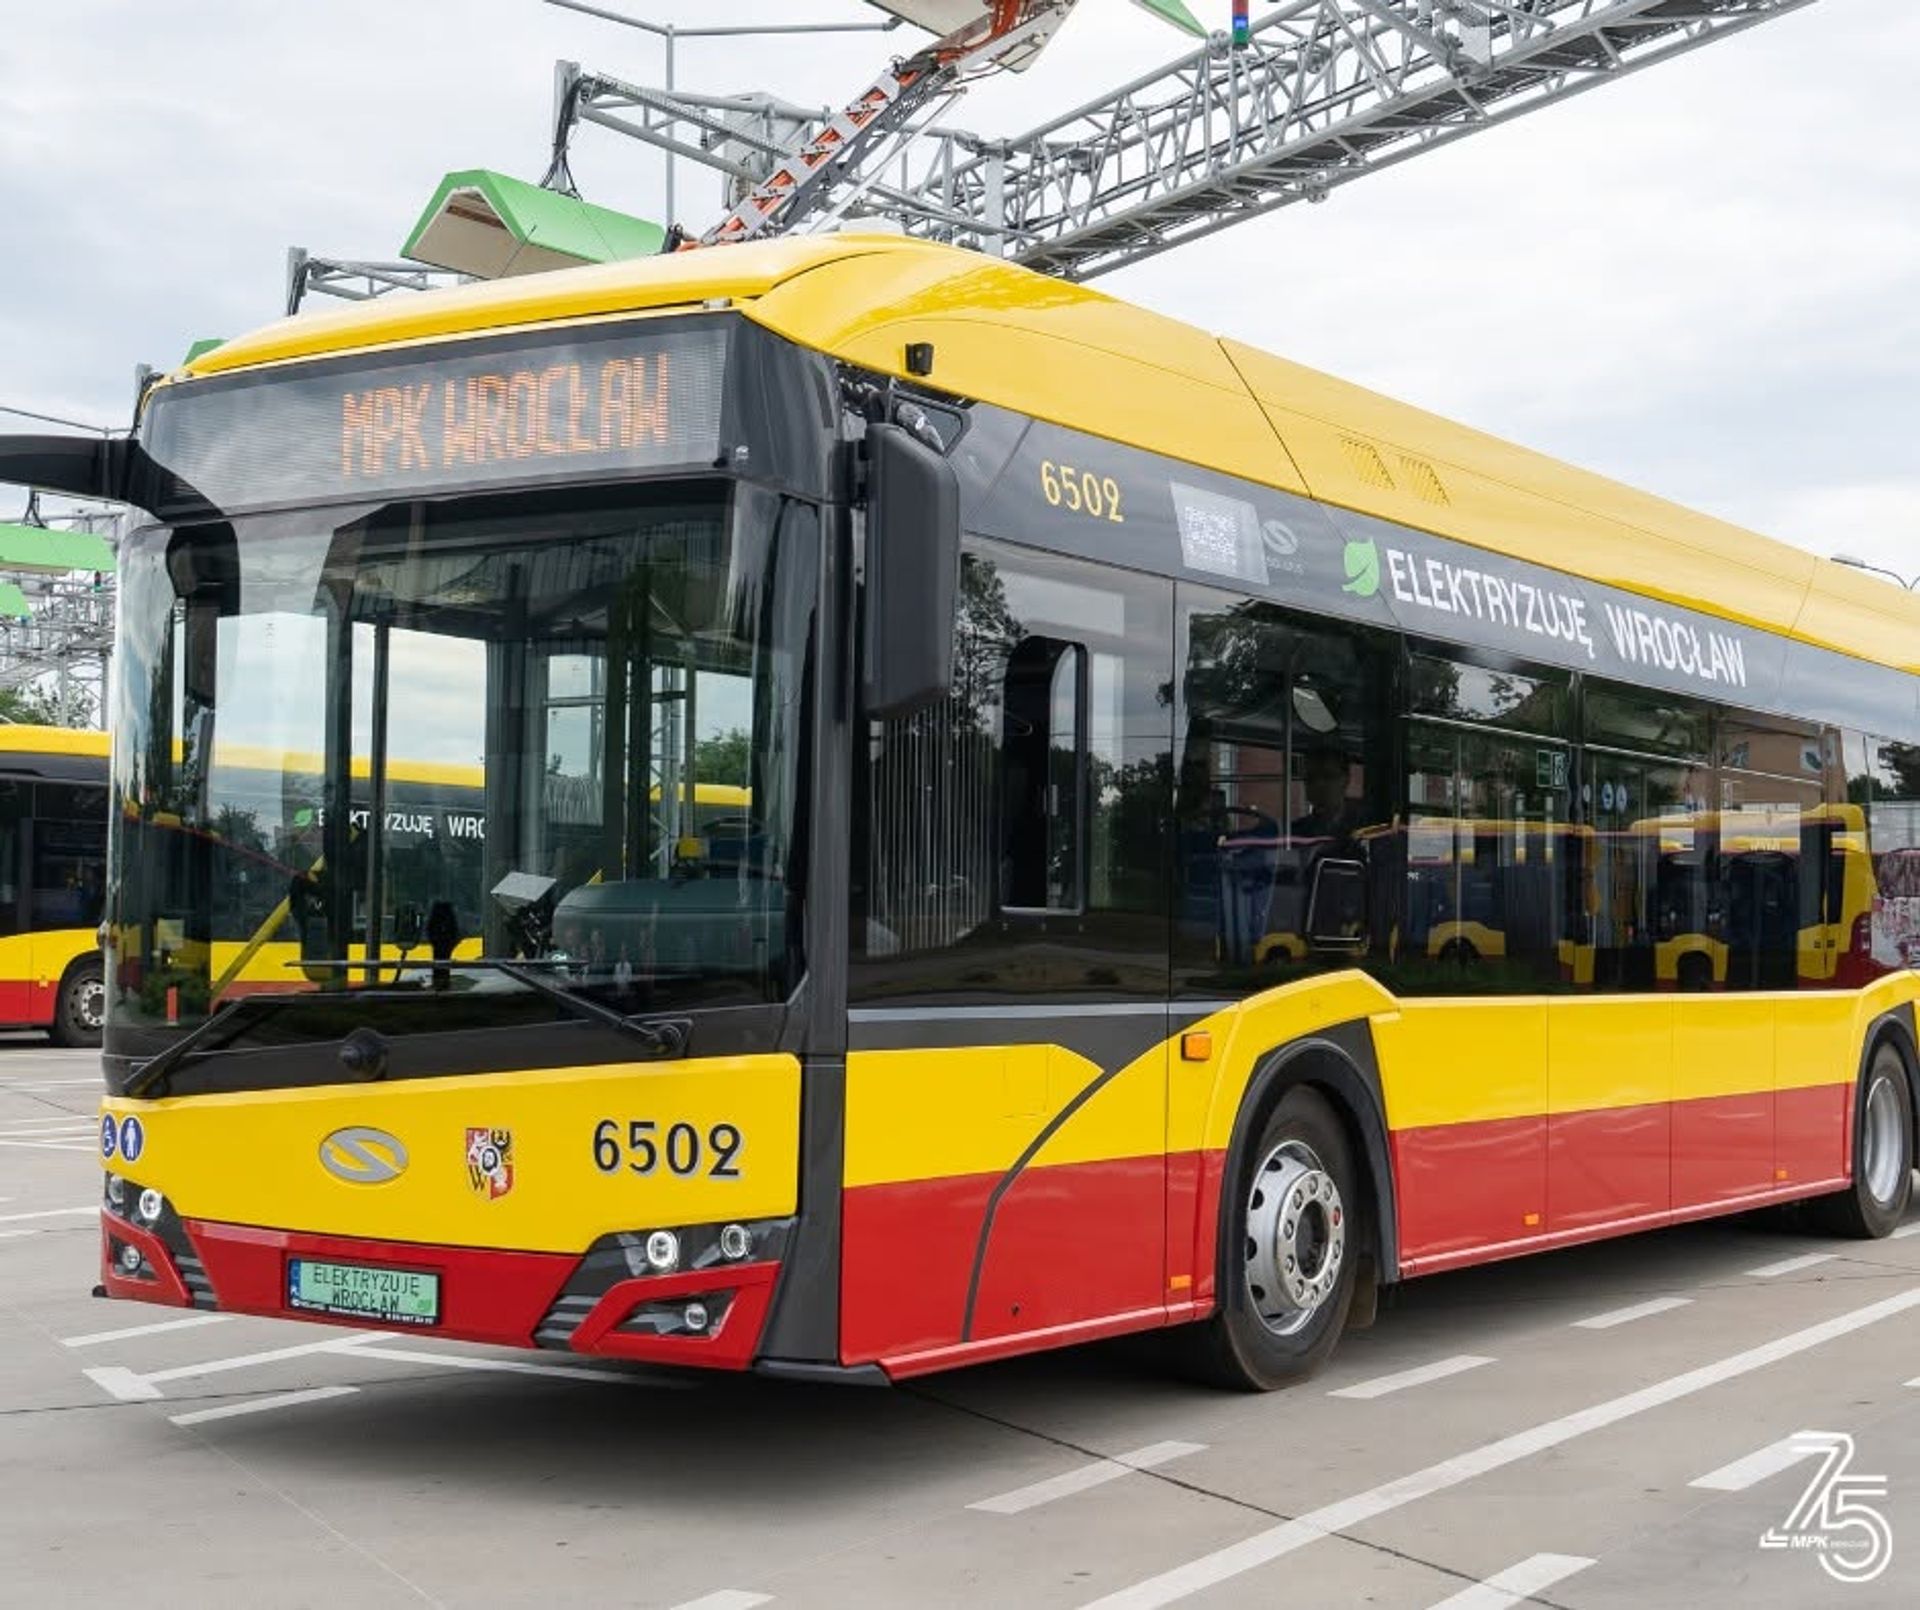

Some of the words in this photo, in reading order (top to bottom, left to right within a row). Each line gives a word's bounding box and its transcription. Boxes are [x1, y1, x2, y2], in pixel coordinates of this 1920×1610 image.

[342, 382, 430, 478] MPK
[443, 352, 670, 467] WROCŁAW
[1041, 461, 1124, 522] 6502
[1386, 549, 1595, 658] ELEKTRYZUJĘ
[1605, 603, 1747, 687] WROCŁAW
[318, 807, 433, 838] EKTYZUJĘ
[447, 815, 485, 839] WRO
[593, 1119, 743, 1178] 6502
[314, 1266, 420, 1298] ELEKTRYZUJĘ
[333, 1289, 399, 1312] WROCŁAW
